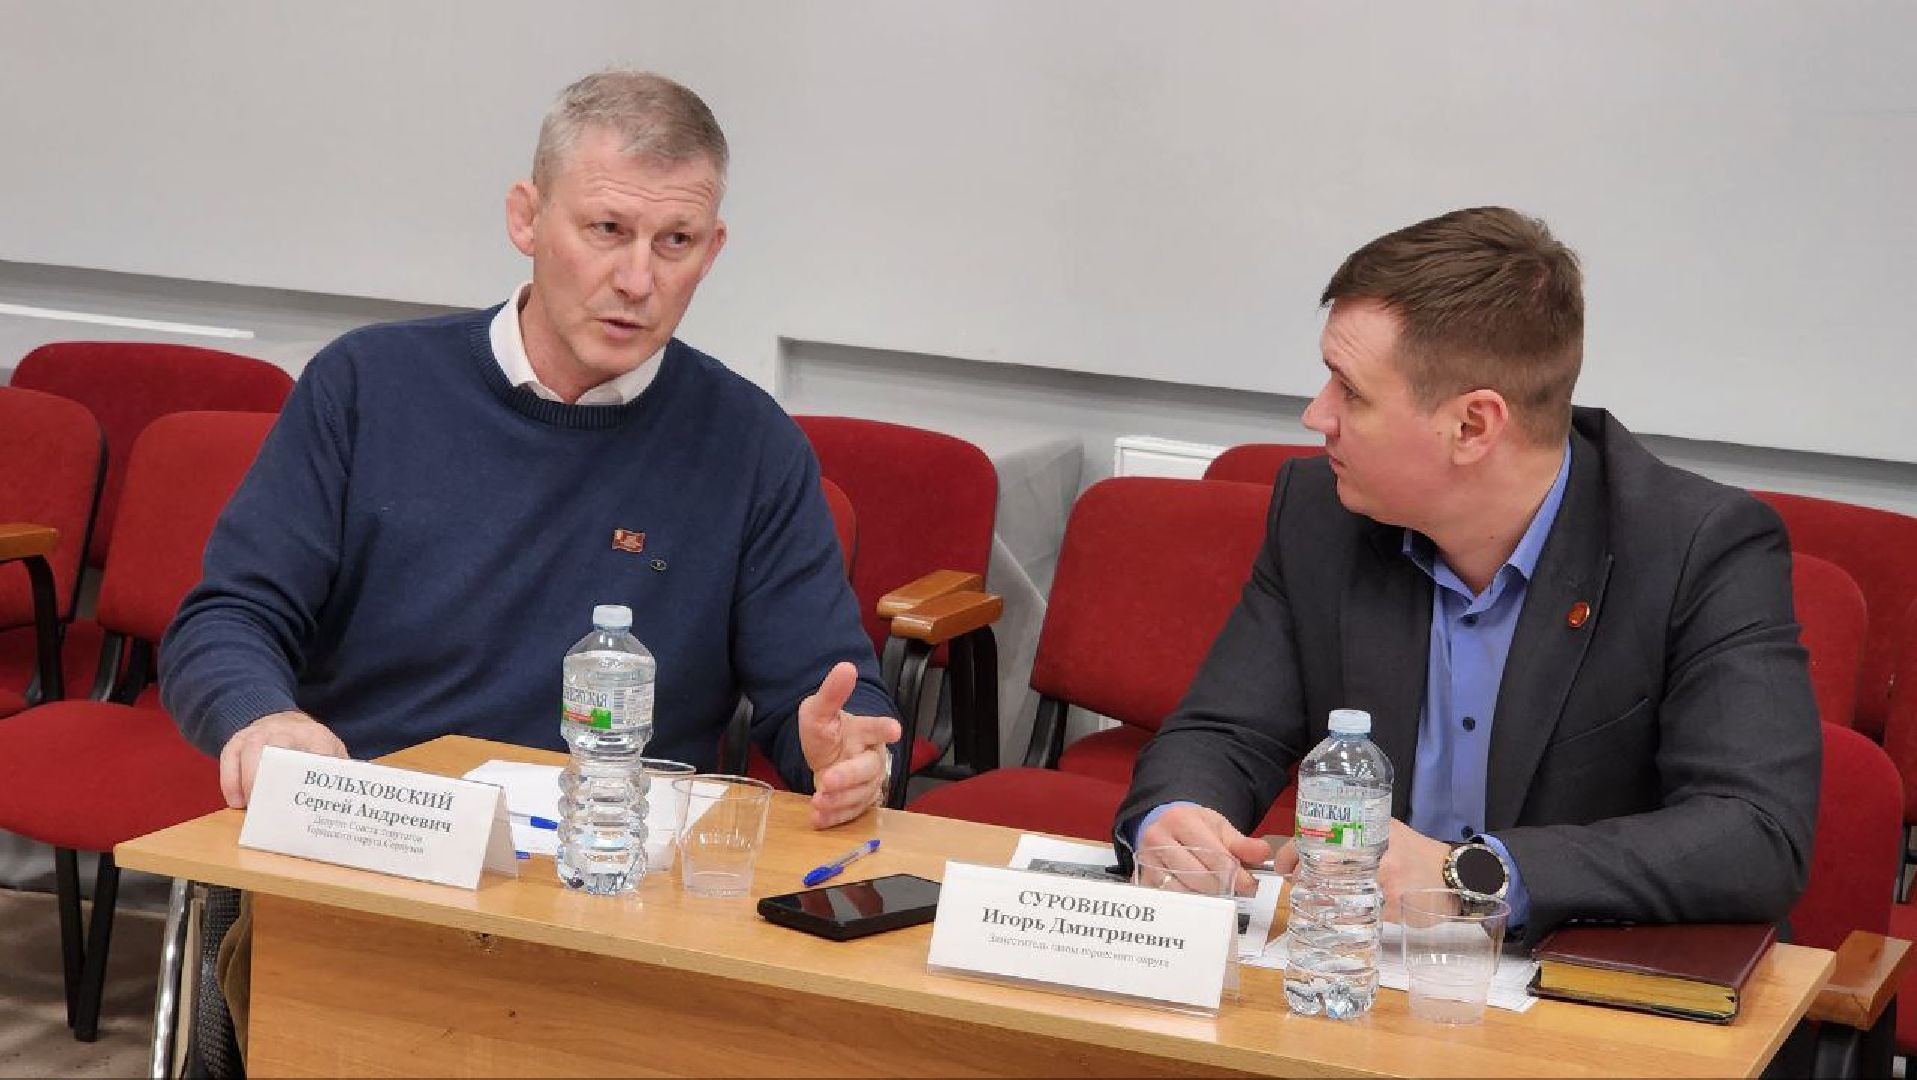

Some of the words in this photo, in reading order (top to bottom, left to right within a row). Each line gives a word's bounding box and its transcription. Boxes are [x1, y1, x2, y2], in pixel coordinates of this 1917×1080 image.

[304, 769, 455, 811] ВОЛЬХОВСКИЙ
[294, 791, 351, 815] Сергей
[355, 803, 452, 833] Андреевич
[1018, 889, 1156, 922] СУРОВИКОВ
[981, 906, 1046, 932] Игорь
[1049, 916, 1186, 950] Дмитриевич
